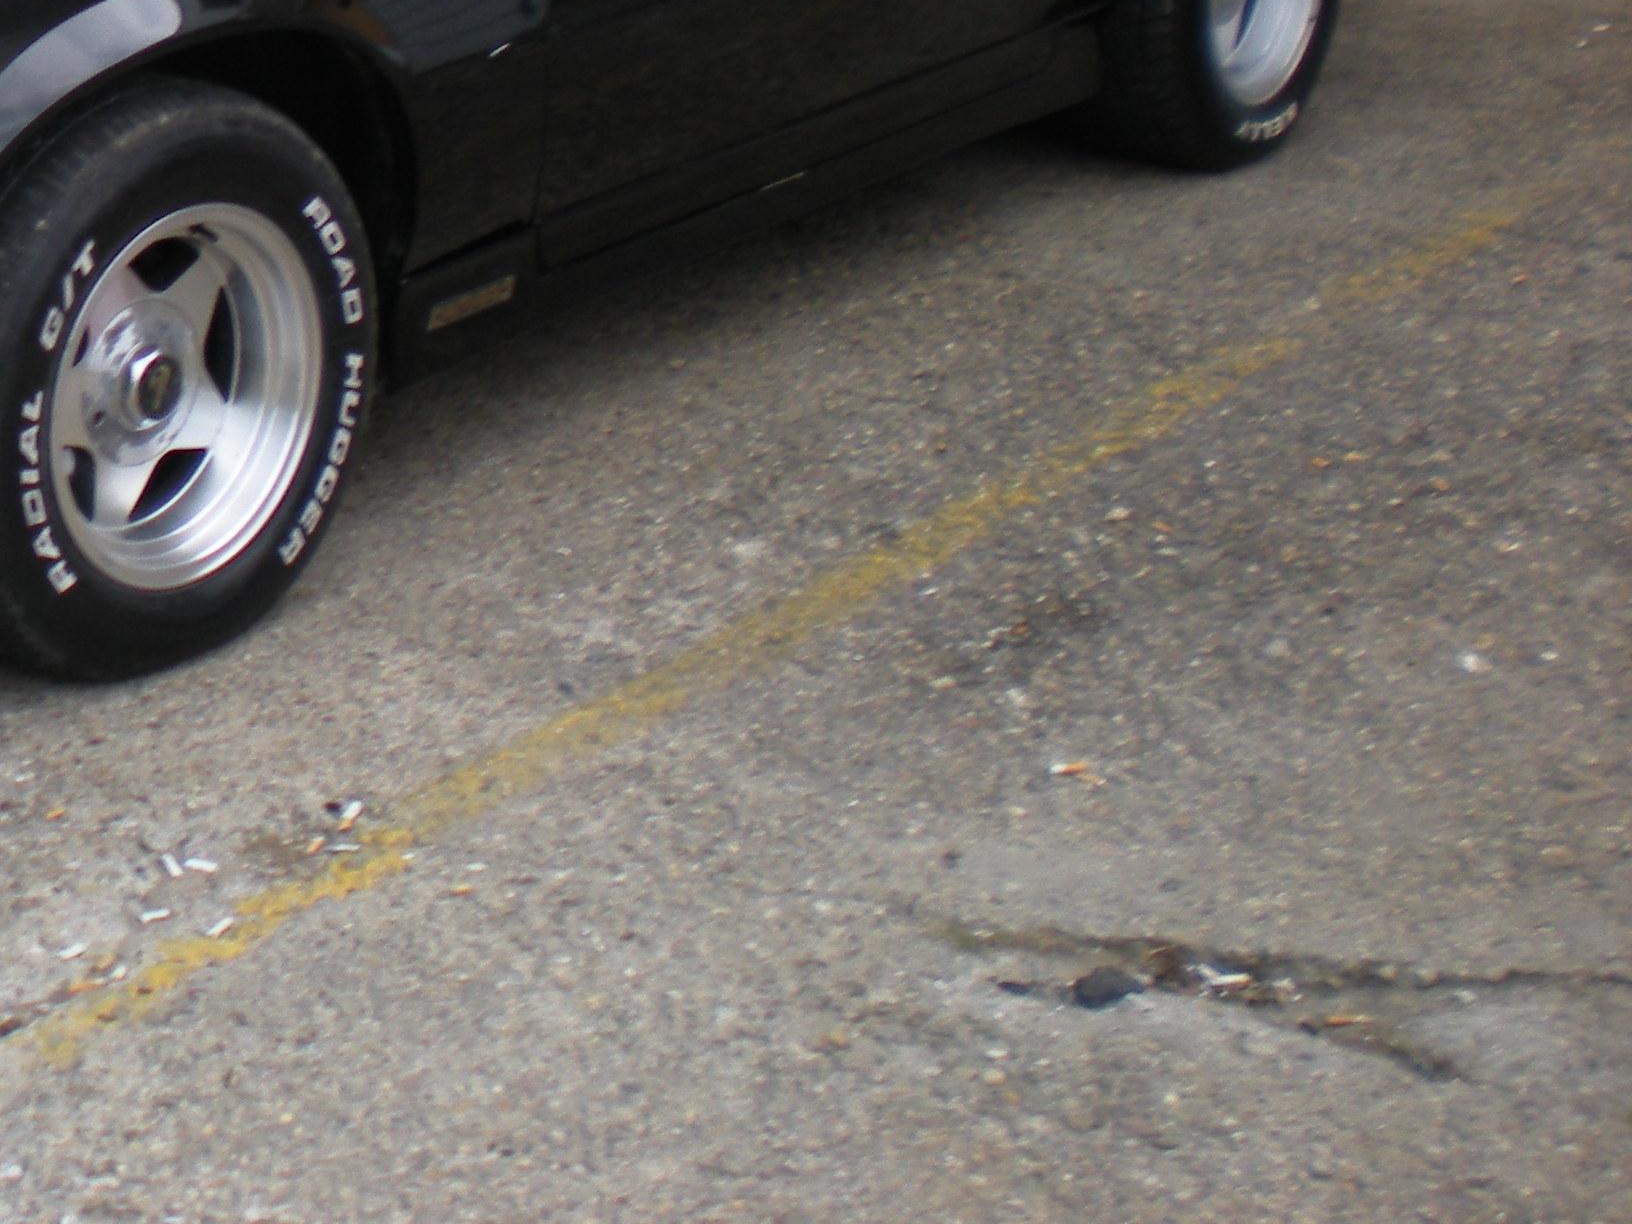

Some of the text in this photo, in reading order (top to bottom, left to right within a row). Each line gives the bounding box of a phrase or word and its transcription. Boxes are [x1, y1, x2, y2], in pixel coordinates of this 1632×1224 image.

[19, 238, 96, 595] RADIAL G/T
[278, 196, 364, 566] ROAD HUGGER
